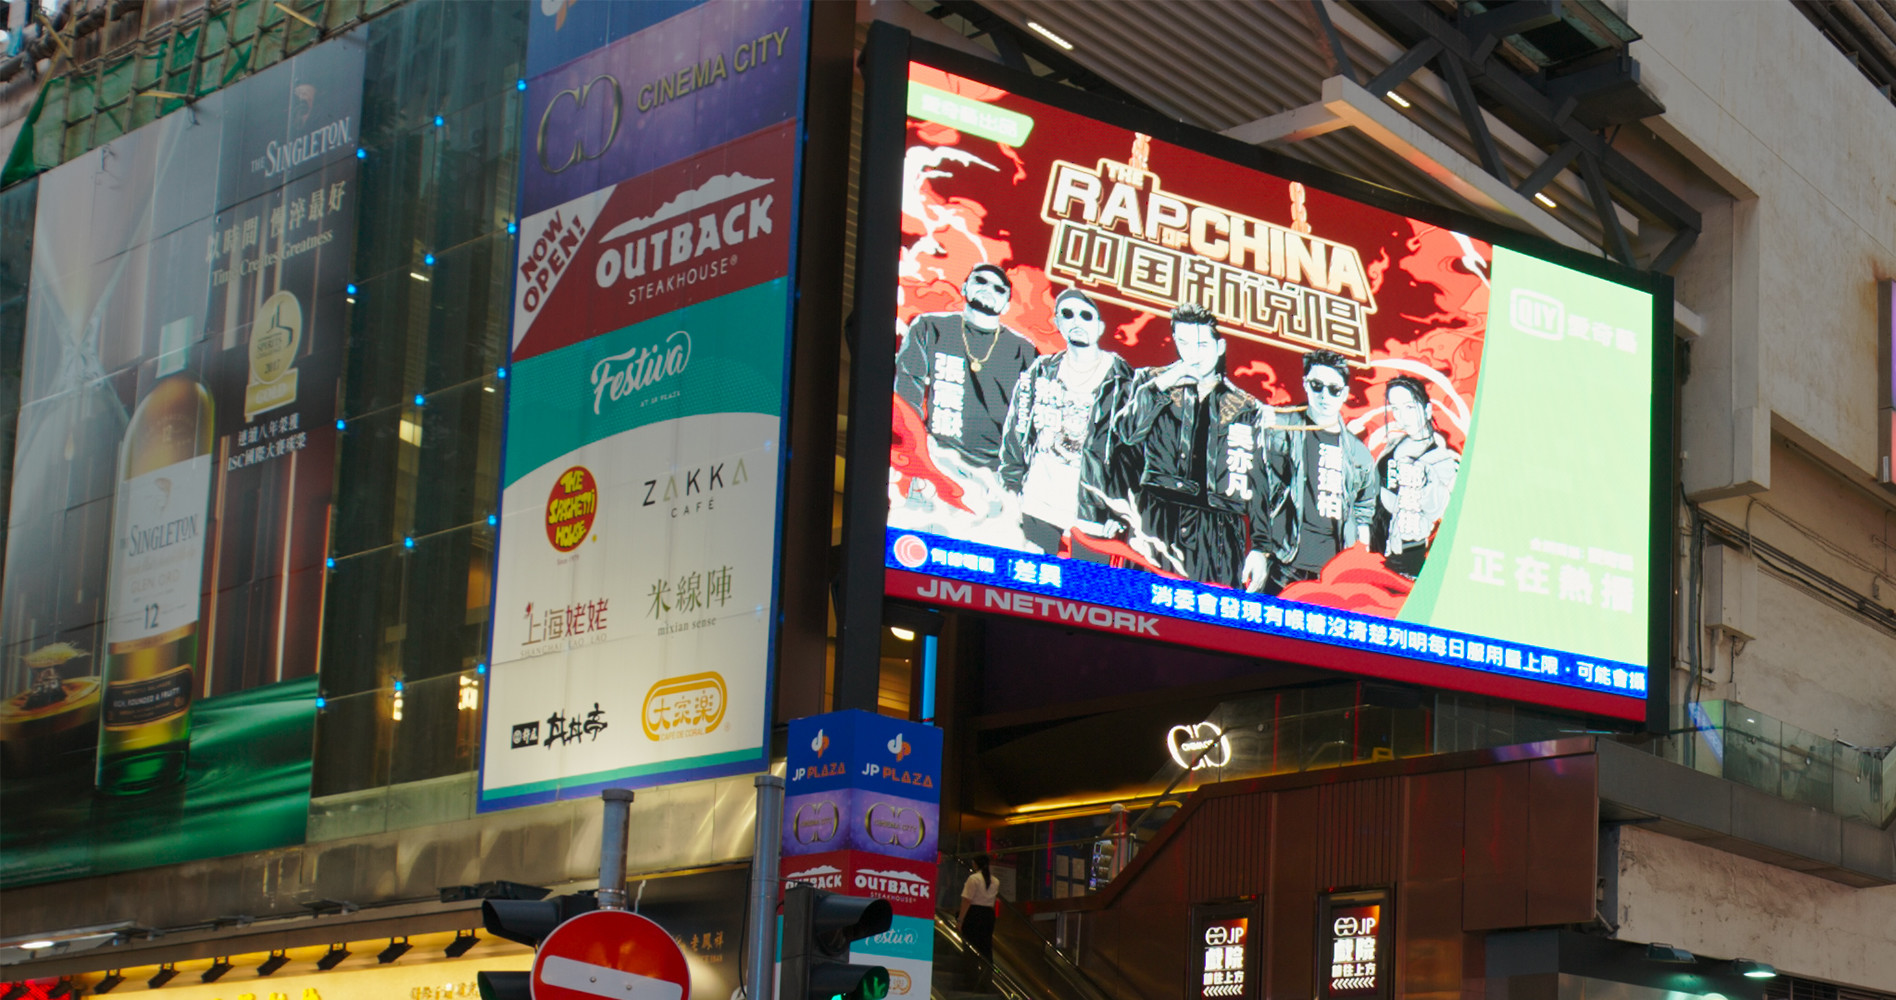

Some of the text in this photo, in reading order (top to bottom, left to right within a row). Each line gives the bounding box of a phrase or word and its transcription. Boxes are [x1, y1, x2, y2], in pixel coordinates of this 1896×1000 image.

[636, 27, 790, 113] CINEMA CITY
[251, 116, 352, 177] THE SINGLETON
[1107, 162, 1143, 188] THE
[1052, 166, 1189, 241] RAP
[282, 229, 333, 259] Greatness
[519, 209, 564, 283] NOW
[595, 193, 775, 289] OUTBACK
[1189, 204, 1369, 300] CHINA
[523, 215, 587, 314] OPEN!
[590, 330, 692, 416] Festiva
[561, 470, 584, 494] THE
[1226, 422, 1254, 500] 吳亦凡
[128, 513, 199, 557] SINGLETON
[556, 520, 587, 547] HOUSE
[646, 565, 734, 621] 米線陣
[917, 579, 1160, 637] JM NETWORK
[144, 602, 159, 630] 12
[521, 598, 610, 646] 上海姥姥
[657, 617, 717, 637] mixian sense
[568, 637, 584, 650] LAO
[591, 633, 608, 645] LAO
[792, 762, 846, 781] JP PLAZA
[862, 763, 933, 788] JP PLAZA
[855, 874, 930, 899] OUTBACK
[1227, 927, 1245, 944] JP
[1358, 917, 1376, 935] JP
